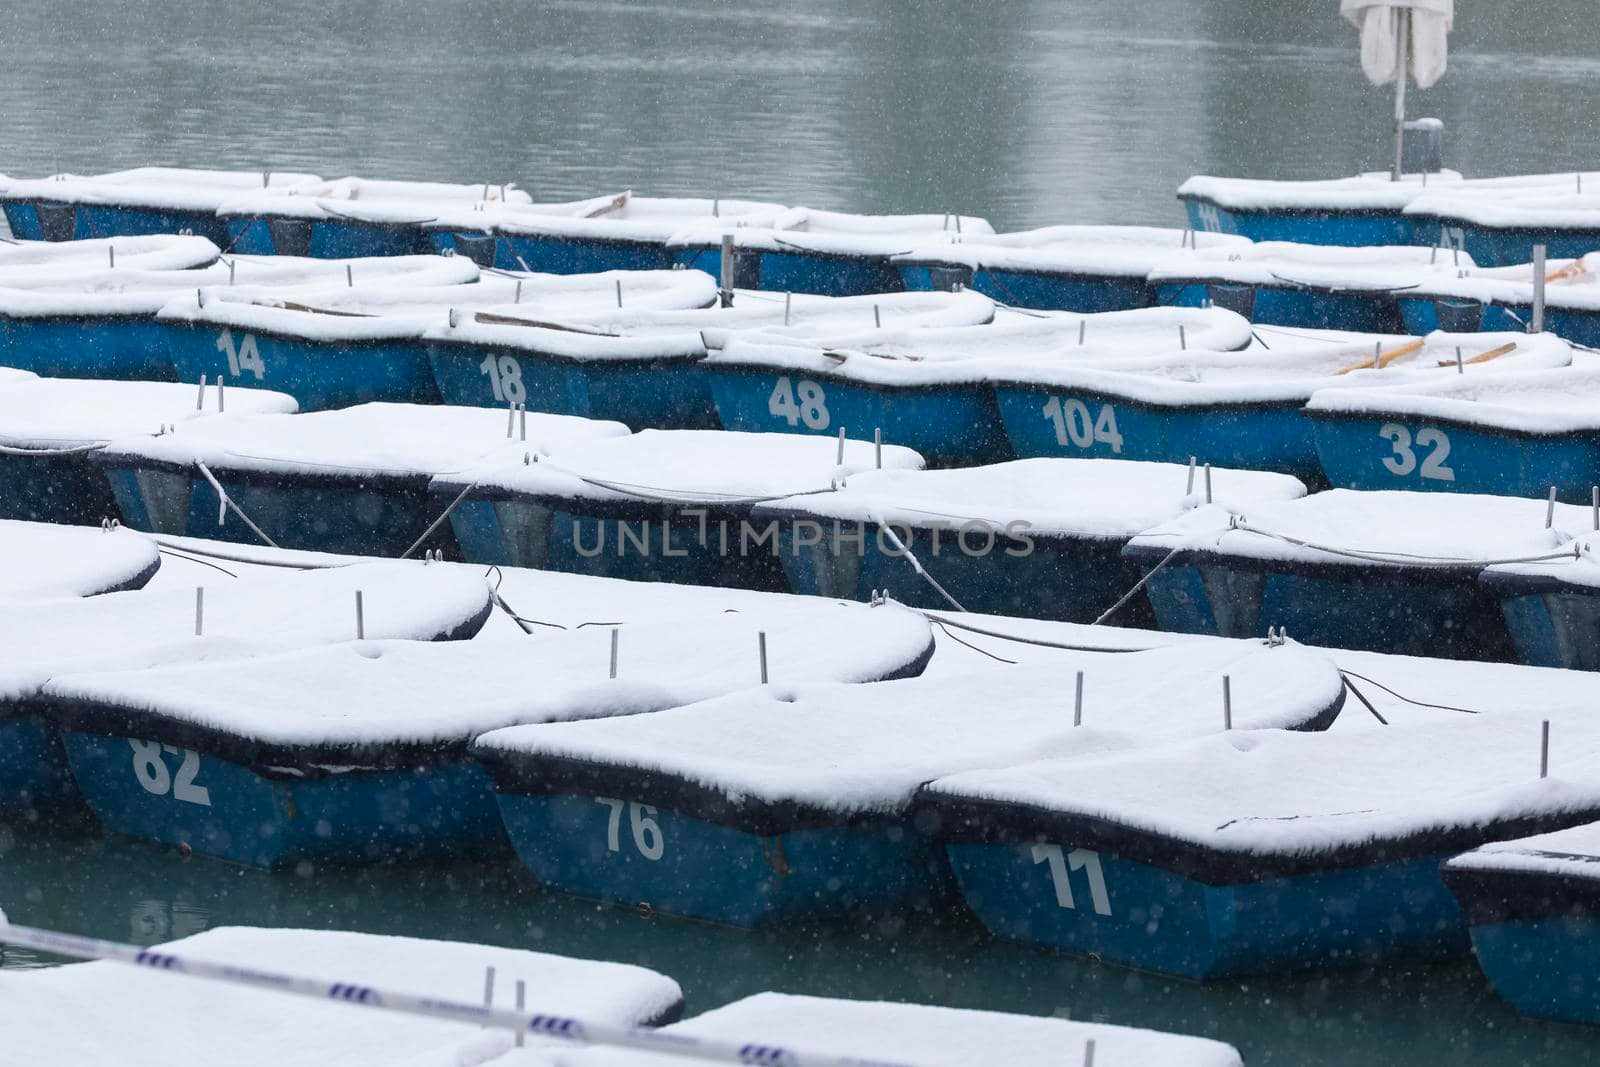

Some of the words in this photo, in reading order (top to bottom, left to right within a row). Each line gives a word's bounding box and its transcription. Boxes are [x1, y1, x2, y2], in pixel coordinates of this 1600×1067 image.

[216, 329, 265, 380] 14
[479, 353, 527, 402] 18
[768, 376, 830, 431] 48
[1042, 396, 1123, 453] 104
[1379, 423, 1456, 481] 32
[128, 737, 211, 806] 82
[594, 796, 664, 861] 76
[1031, 842, 1113, 916] 11
